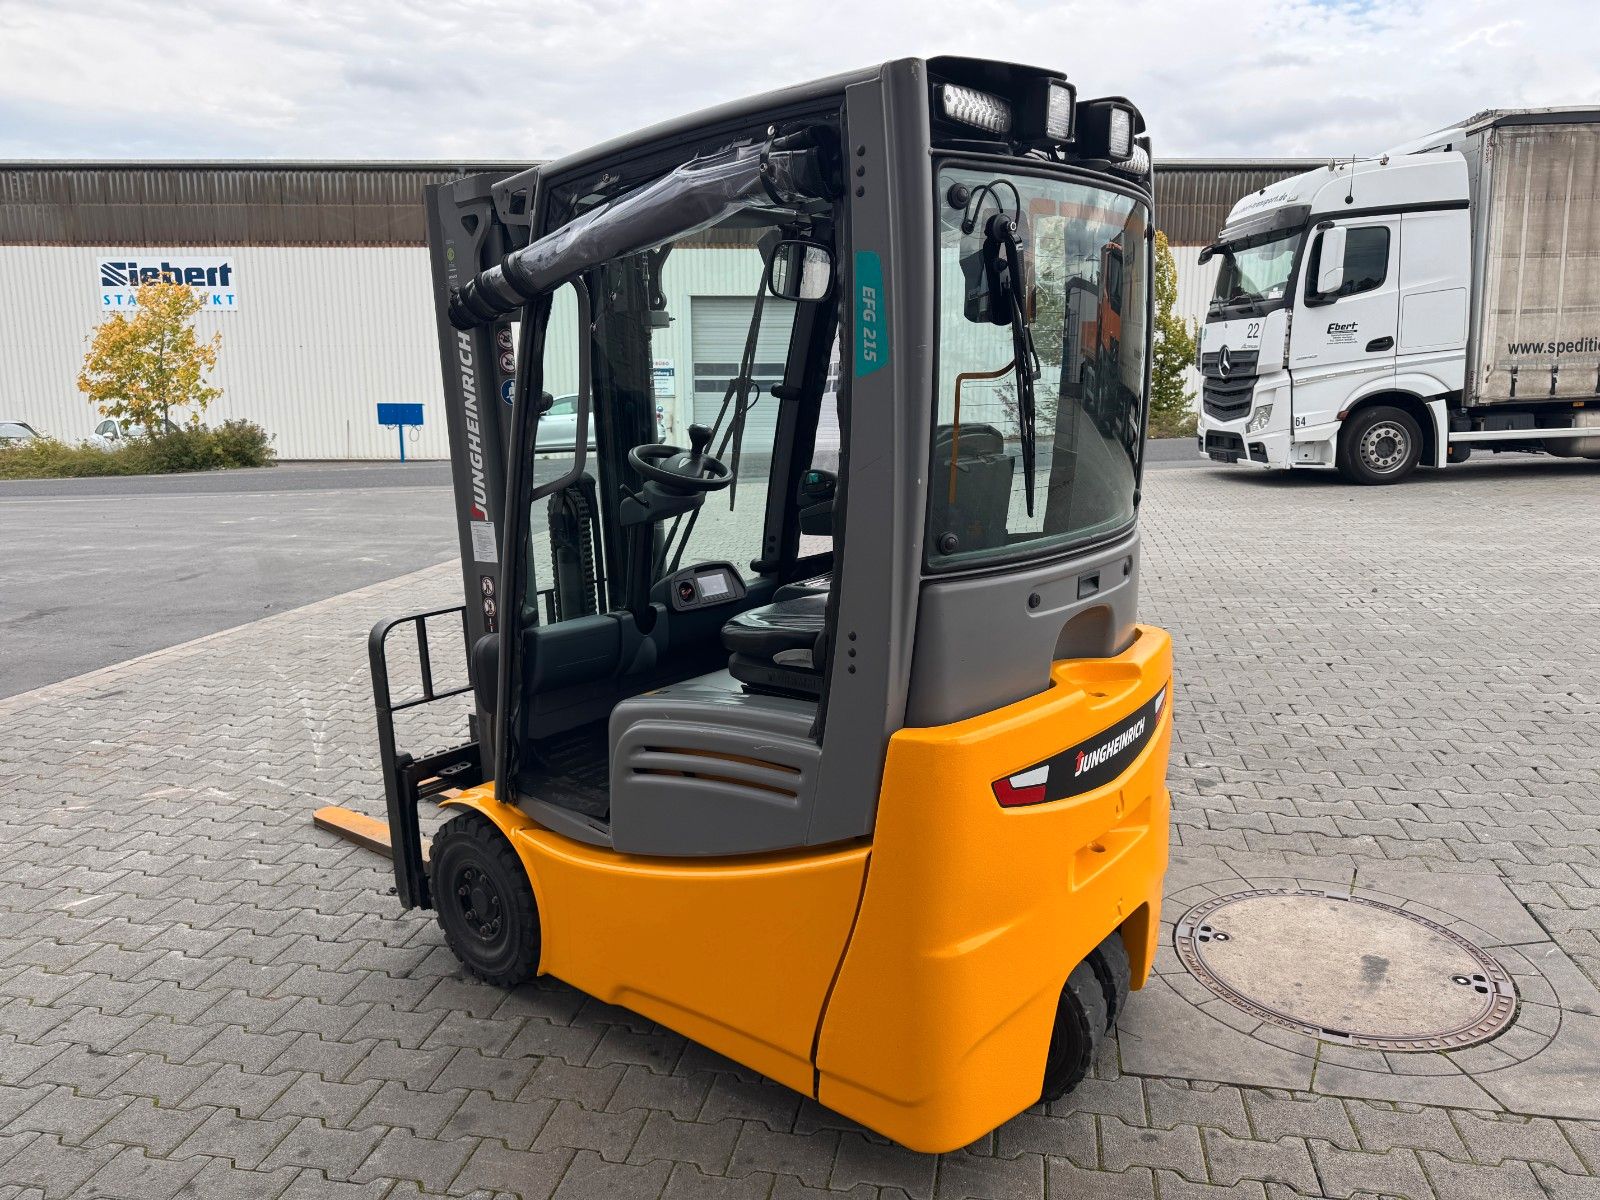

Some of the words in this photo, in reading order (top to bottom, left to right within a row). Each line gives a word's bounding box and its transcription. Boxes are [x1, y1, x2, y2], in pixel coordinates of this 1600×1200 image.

[100, 262, 232, 287] Siebert
[862, 285, 876, 322] EFG
[1246, 322, 1260, 339] 22
[1326, 321, 1359, 334] Ebert
[863, 326, 877, 363] 215
[457, 330, 489, 522] JUNGHEINRICH
[1295, 416, 1306, 427] 64
[1074, 716, 1146, 778] JUNGHEINRICH
